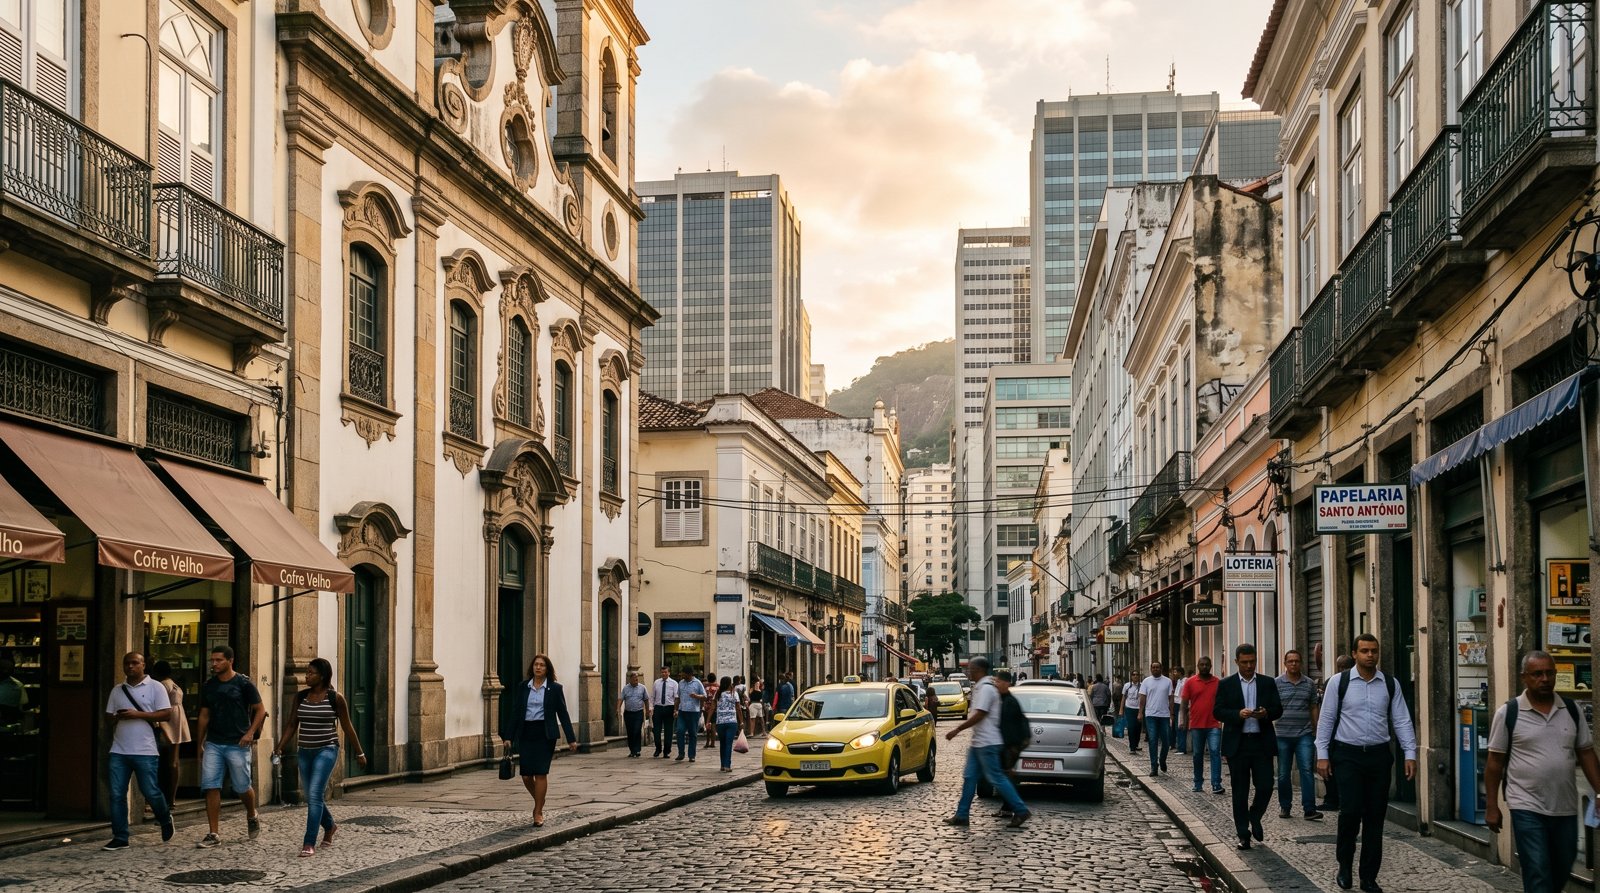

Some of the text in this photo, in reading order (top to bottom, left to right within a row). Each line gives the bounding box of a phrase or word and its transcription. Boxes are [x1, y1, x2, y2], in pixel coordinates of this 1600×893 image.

[1321, 488, 1403, 503] PAPELARIA
[1319, 502, 1405, 517] SANTO ANTÔNIO
[133, 549, 204, 575] Cofre Velho
[1226, 558, 1274, 570] LOTERIA
[279, 569, 331, 589] Cofre Velho
